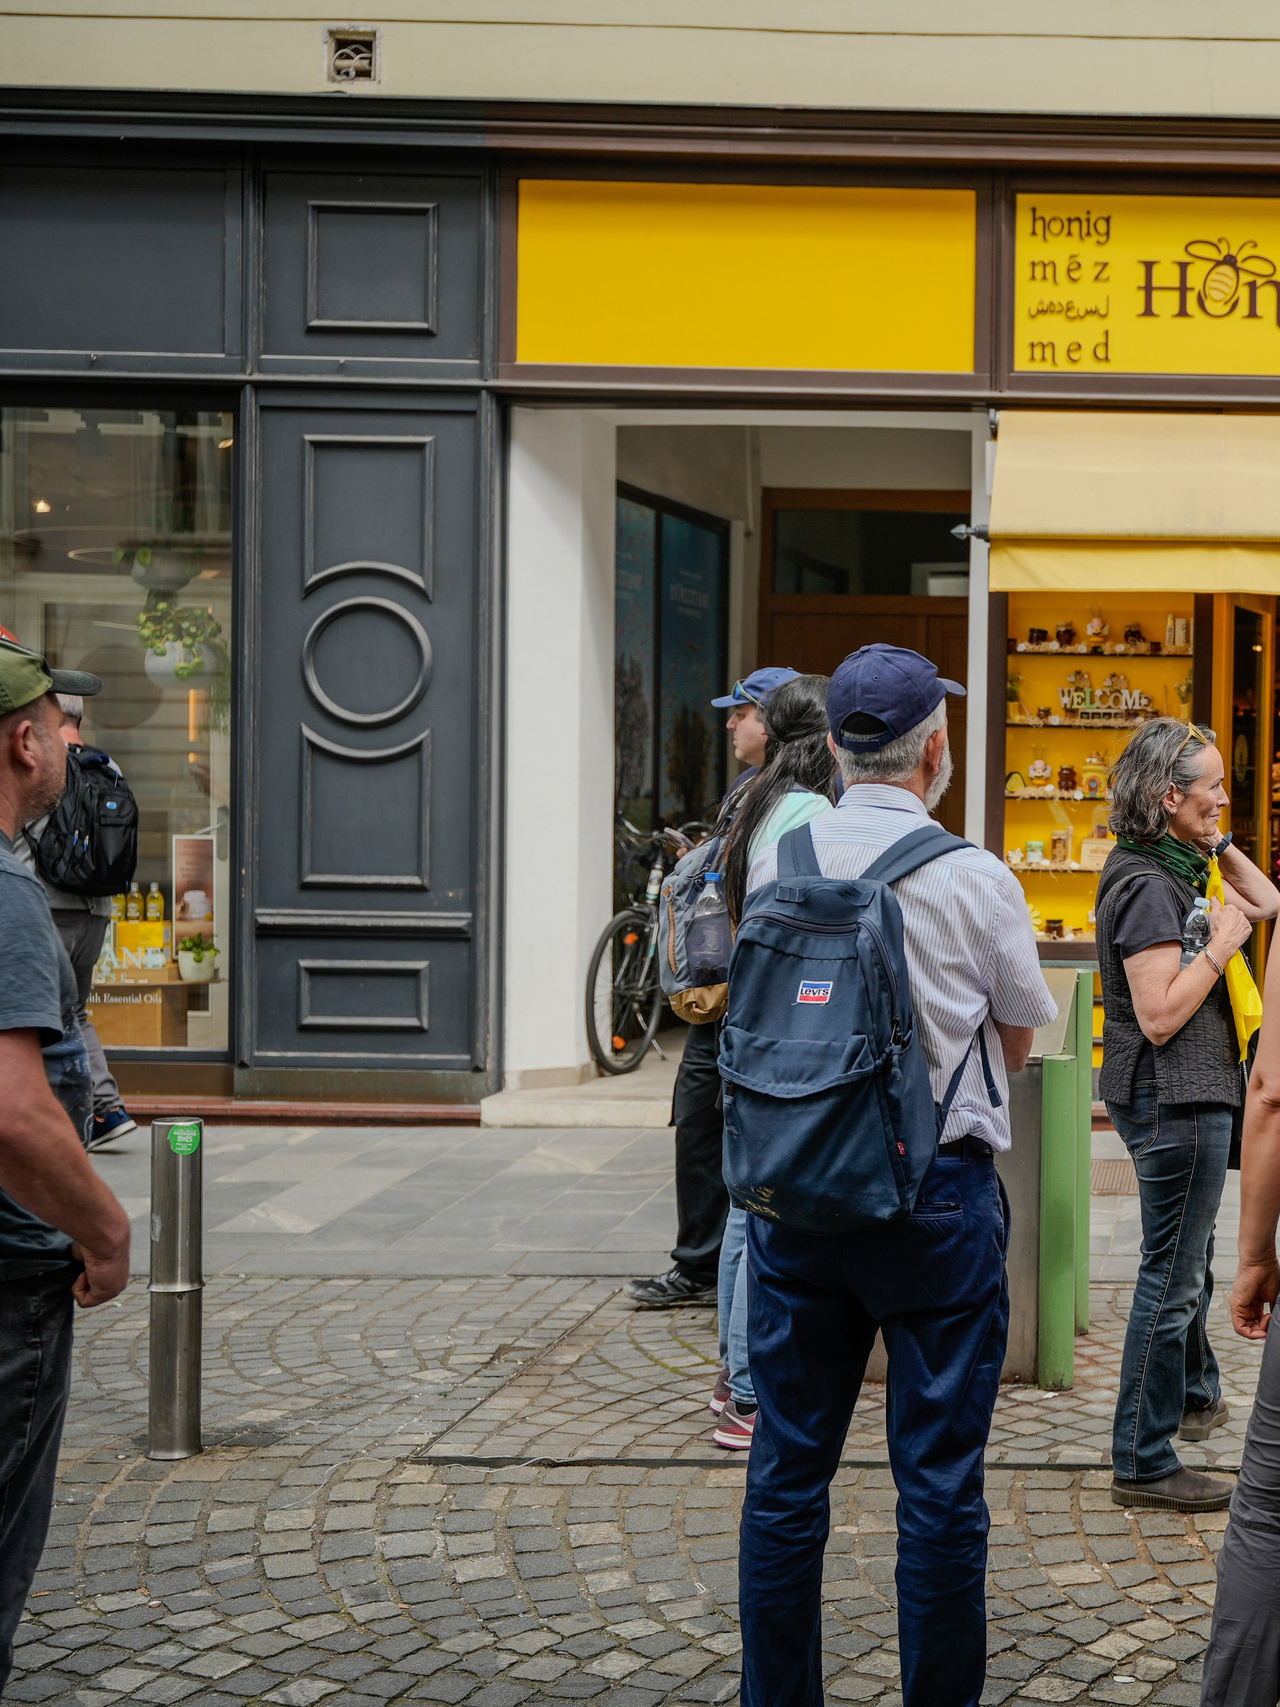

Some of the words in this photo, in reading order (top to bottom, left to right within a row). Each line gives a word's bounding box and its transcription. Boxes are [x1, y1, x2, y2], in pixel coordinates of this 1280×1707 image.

[1030, 206, 1111, 245] honig
[1029, 329, 1111, 367] med
[104, 992, 142, 1004] Essential
